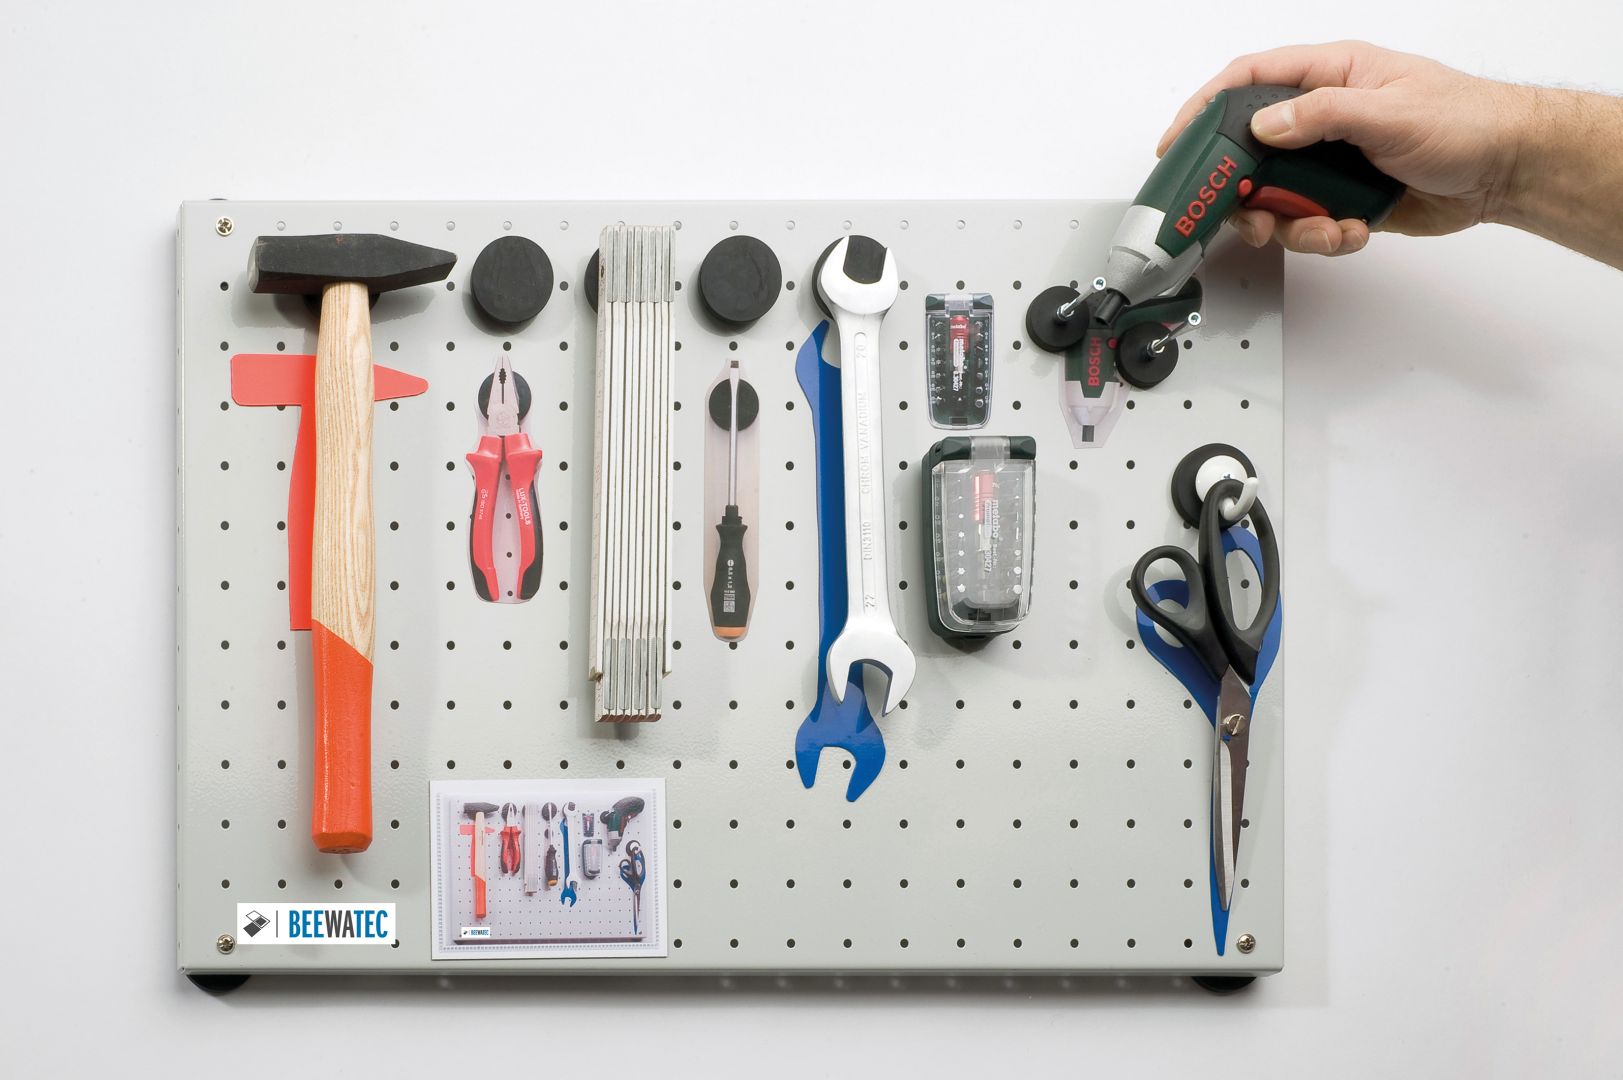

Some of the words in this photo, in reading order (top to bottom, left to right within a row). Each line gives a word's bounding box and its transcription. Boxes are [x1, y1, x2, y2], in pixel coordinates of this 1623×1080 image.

[1175, 155, 1238, 238] BOSCH
[1088, 337, 1102, 387] BOSCH
[992, 499, 1001, 538] metabo
[288, 910, 388, 938] BEEWATEC
